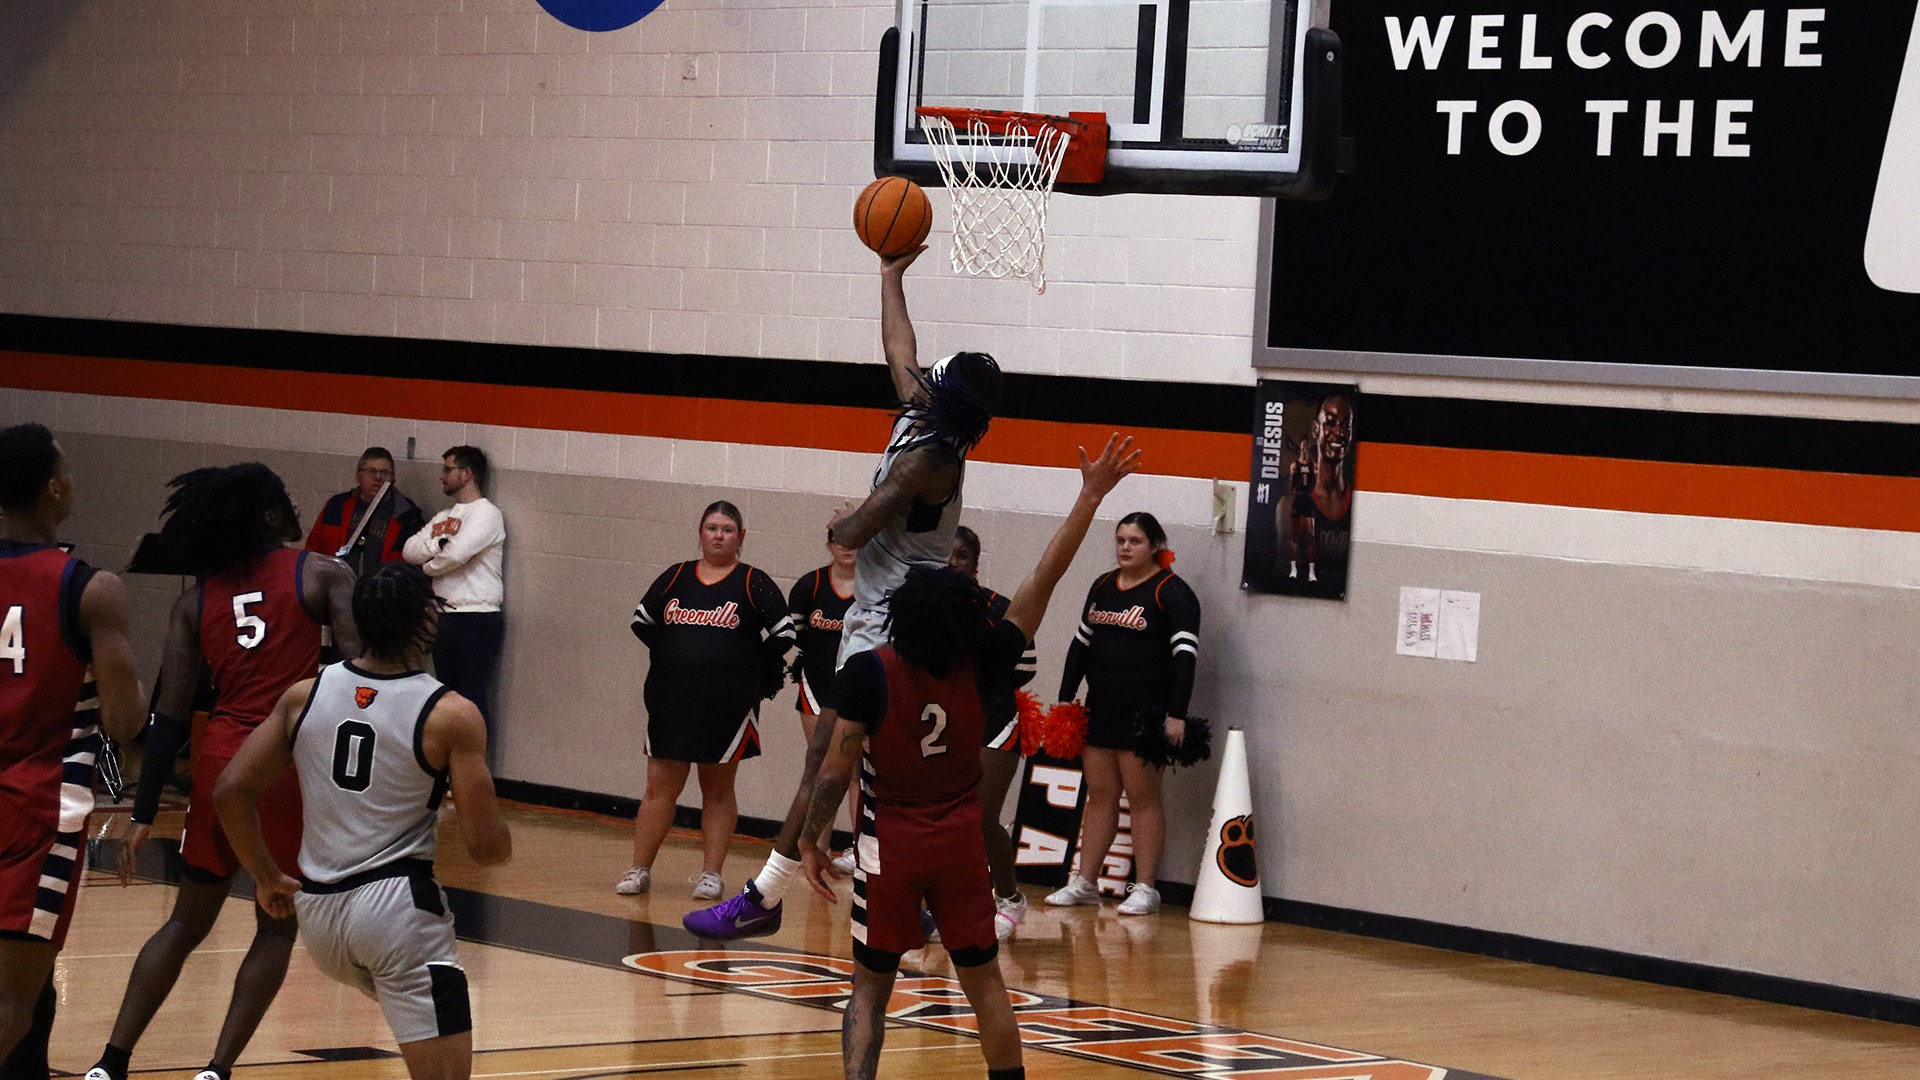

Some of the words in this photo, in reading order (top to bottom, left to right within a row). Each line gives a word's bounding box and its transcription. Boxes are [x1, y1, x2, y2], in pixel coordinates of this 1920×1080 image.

[1384, 8, 1826, 71] WELCOME
[1244, 125, 1286, 138] SCHUTT
[1436, 99, 1542, 156] TO
[1585, 99, 1754, 157] THE
[1262, 401, 1284, 479] DEJESUS
[1257, 482, 1270, 504] #1
[0, 605, 26, 674] 4
[232, 591, 266, 650] 5
[663, 598, 740, 629] Greenville
[331, 718, 376, 793] 0
[920, 703, 947, 758] 2
